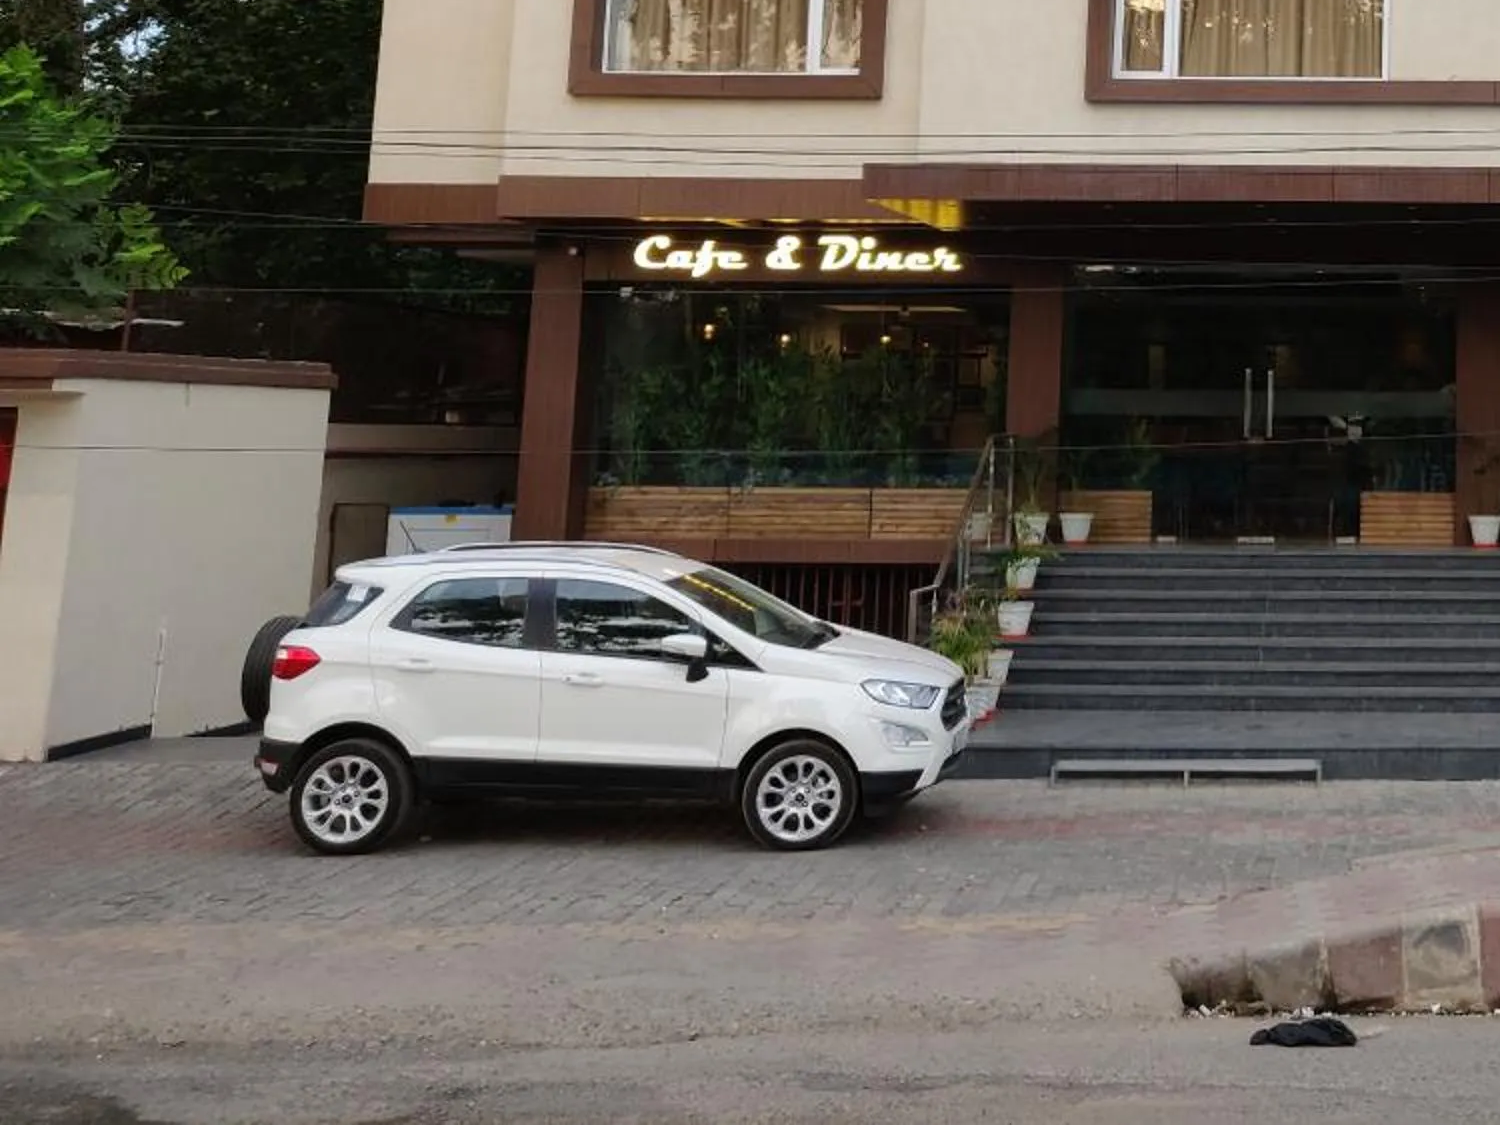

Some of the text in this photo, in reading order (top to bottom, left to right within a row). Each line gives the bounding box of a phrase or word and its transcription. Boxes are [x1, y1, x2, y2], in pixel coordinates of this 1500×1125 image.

[634, 234, 963, 277] Cafe & Diner
